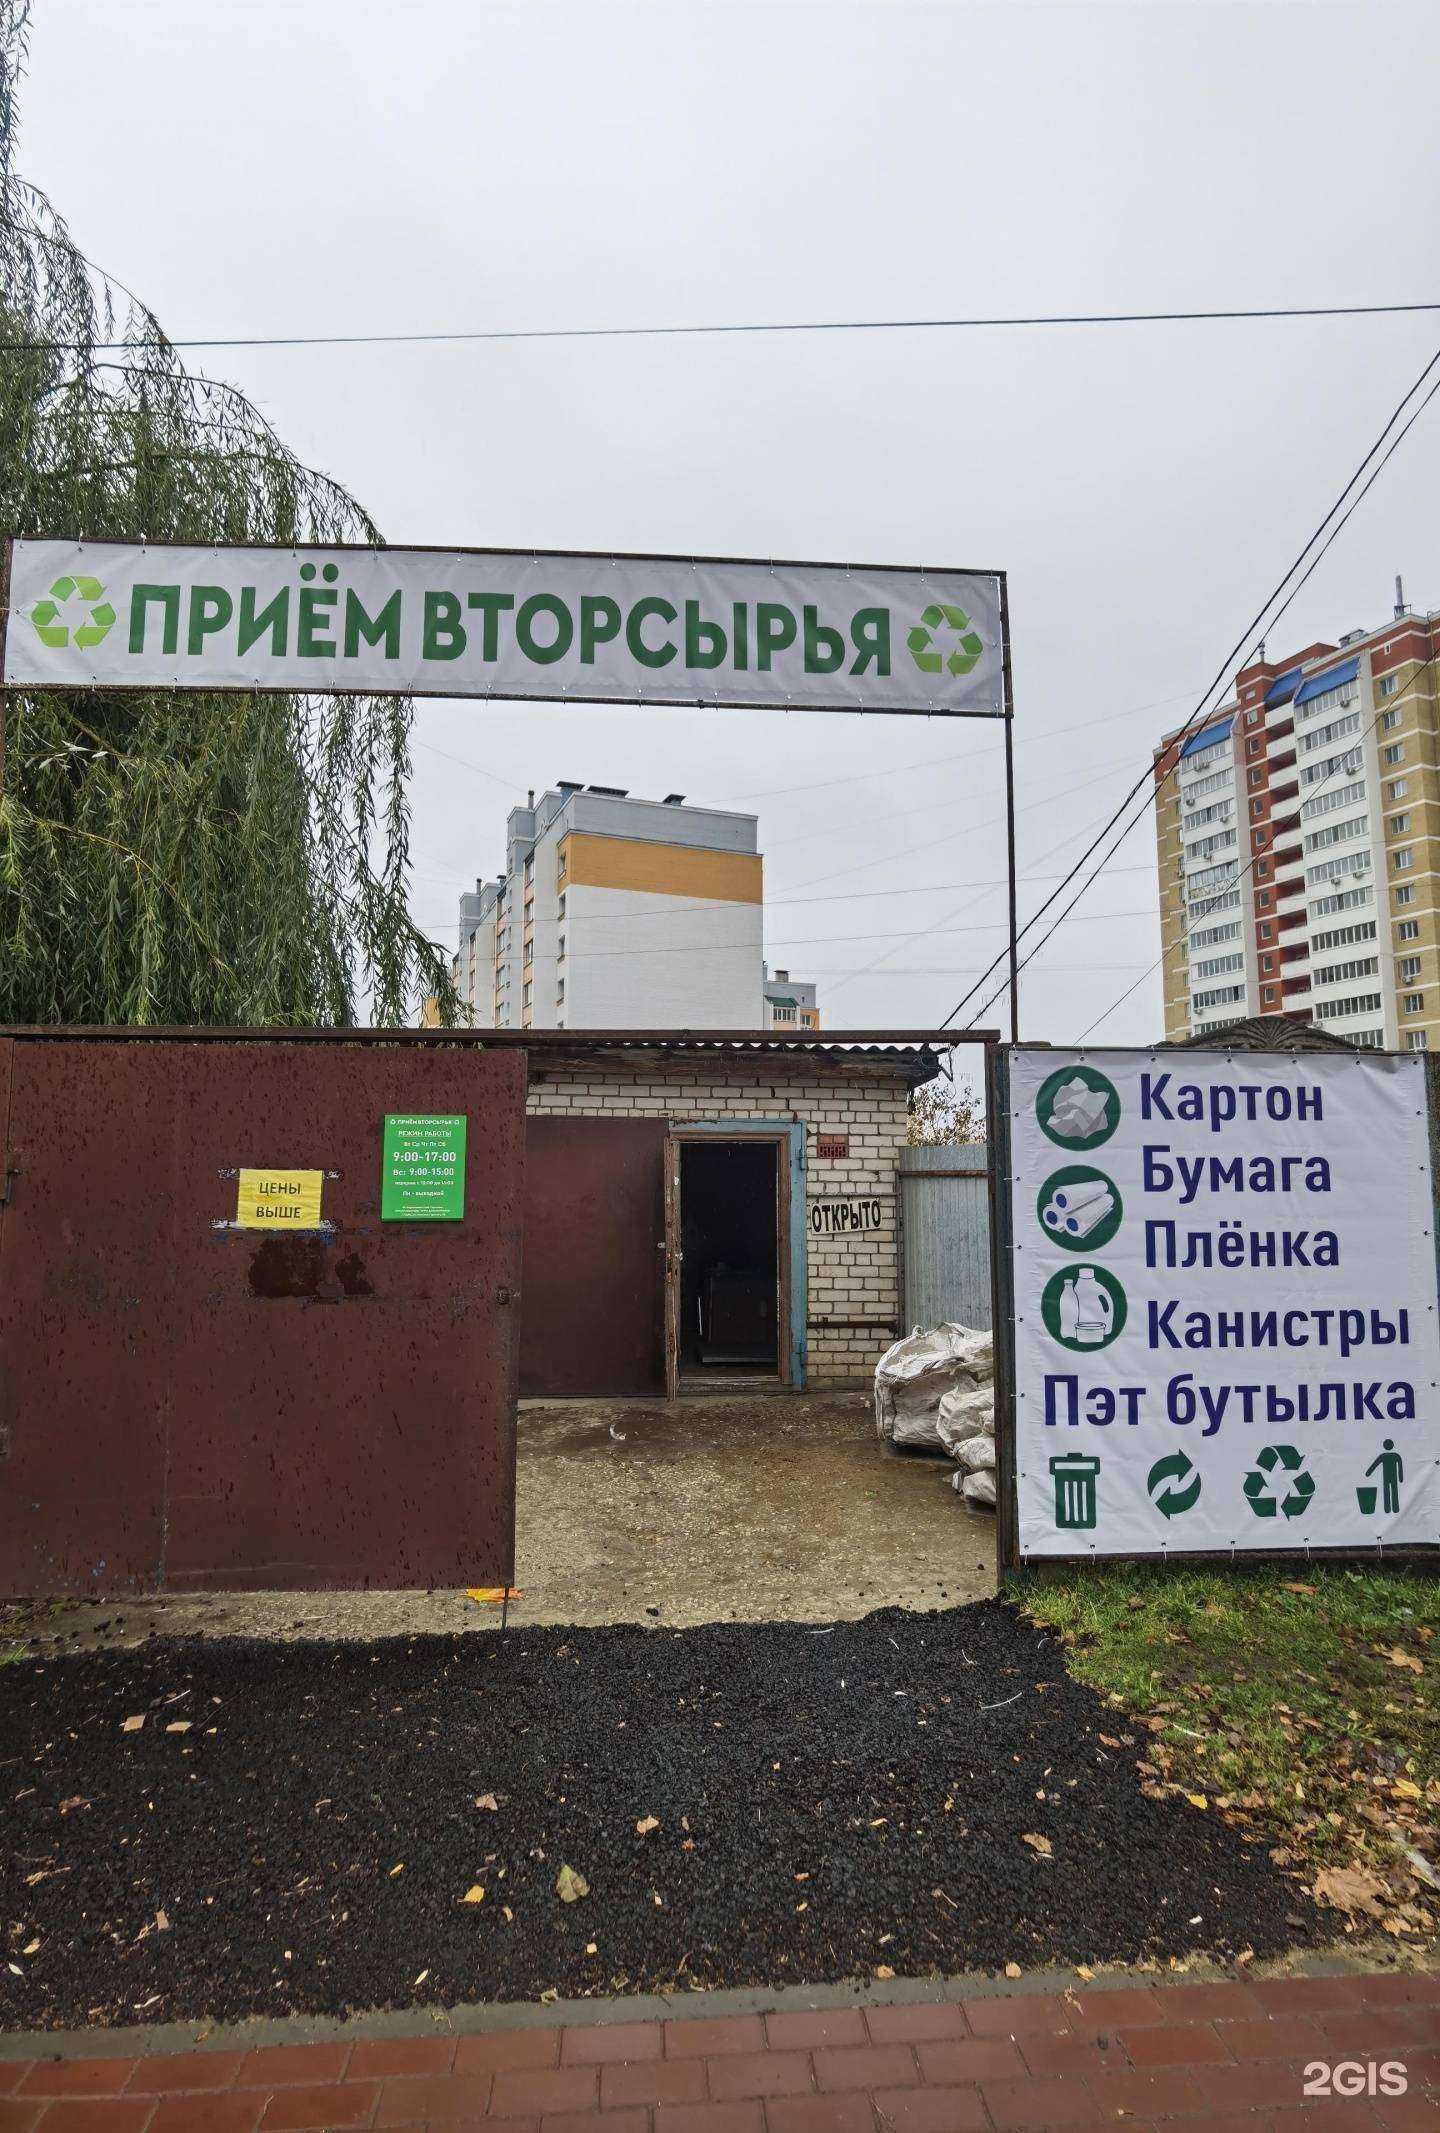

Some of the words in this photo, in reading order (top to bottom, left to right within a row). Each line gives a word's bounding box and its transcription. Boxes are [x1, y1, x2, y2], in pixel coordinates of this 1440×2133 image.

[128, 562, 402, 659] ПРИЁМ
[422, 590, 891, 676] ВТОРСЫРЬЯ
[1140, 1073, 1323, 1132] Картон
[393, 1152, 456, 1162] 9:00-17:00
[409, 1167, 454, 1176] 9:00-15:00
[1143, 1144, 1332, 1204] Бумага
[256, 1206, 301, 1218] ВЫШЕ
[259, 1182, 301, 1196] ЦЕНЫ
[811, 1200, 881, 1233] ОТКРЫТО
[1145, 1219, 1339, 1268] Плёнка
[1148, 1300, 1409, 1357] Канистры
[1044, 1374, 1146, 1426] Пэт
[1167, 1373, 1416, 1436] бутылка
